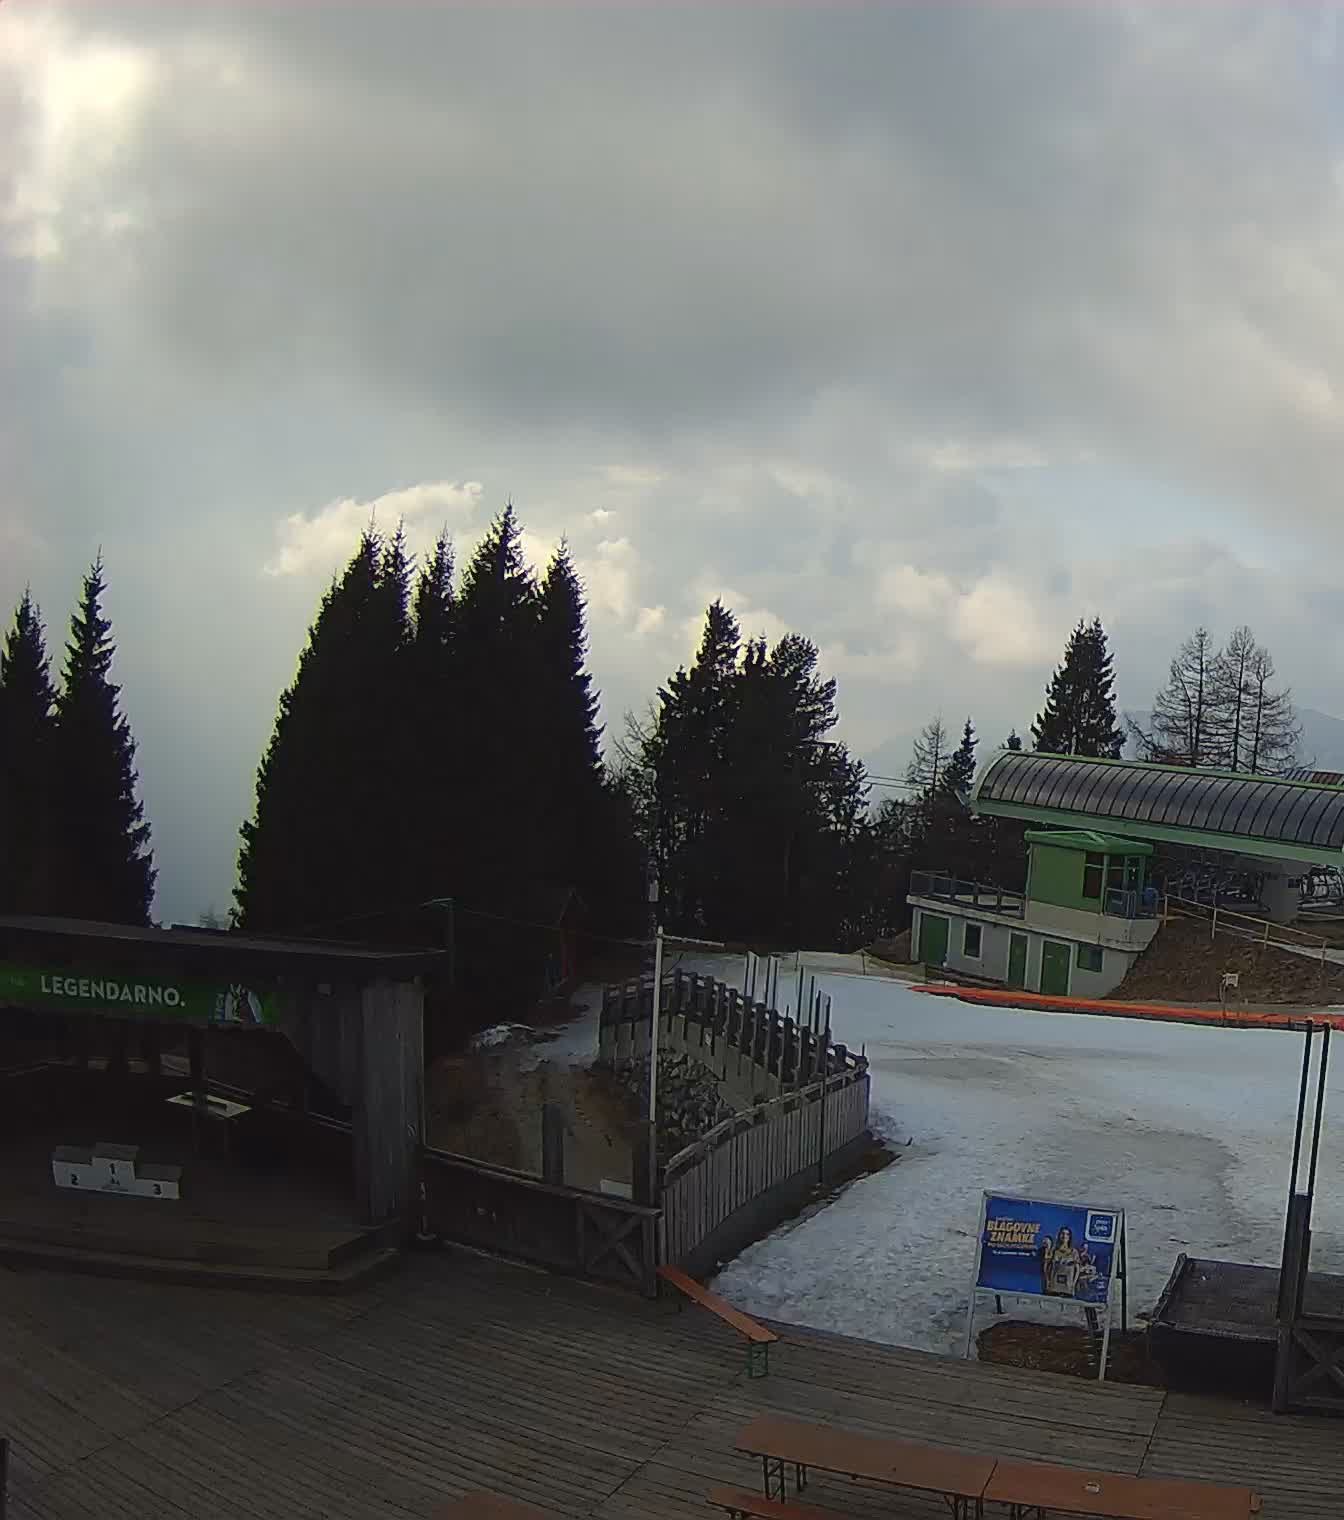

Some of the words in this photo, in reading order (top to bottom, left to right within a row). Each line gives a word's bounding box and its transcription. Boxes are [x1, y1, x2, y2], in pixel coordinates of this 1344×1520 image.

[40, 974, 187, 1008] LEGENDARNO.
[71, 1173, 79, 1186] 2
[153, 1183, 162, 1196] 3
